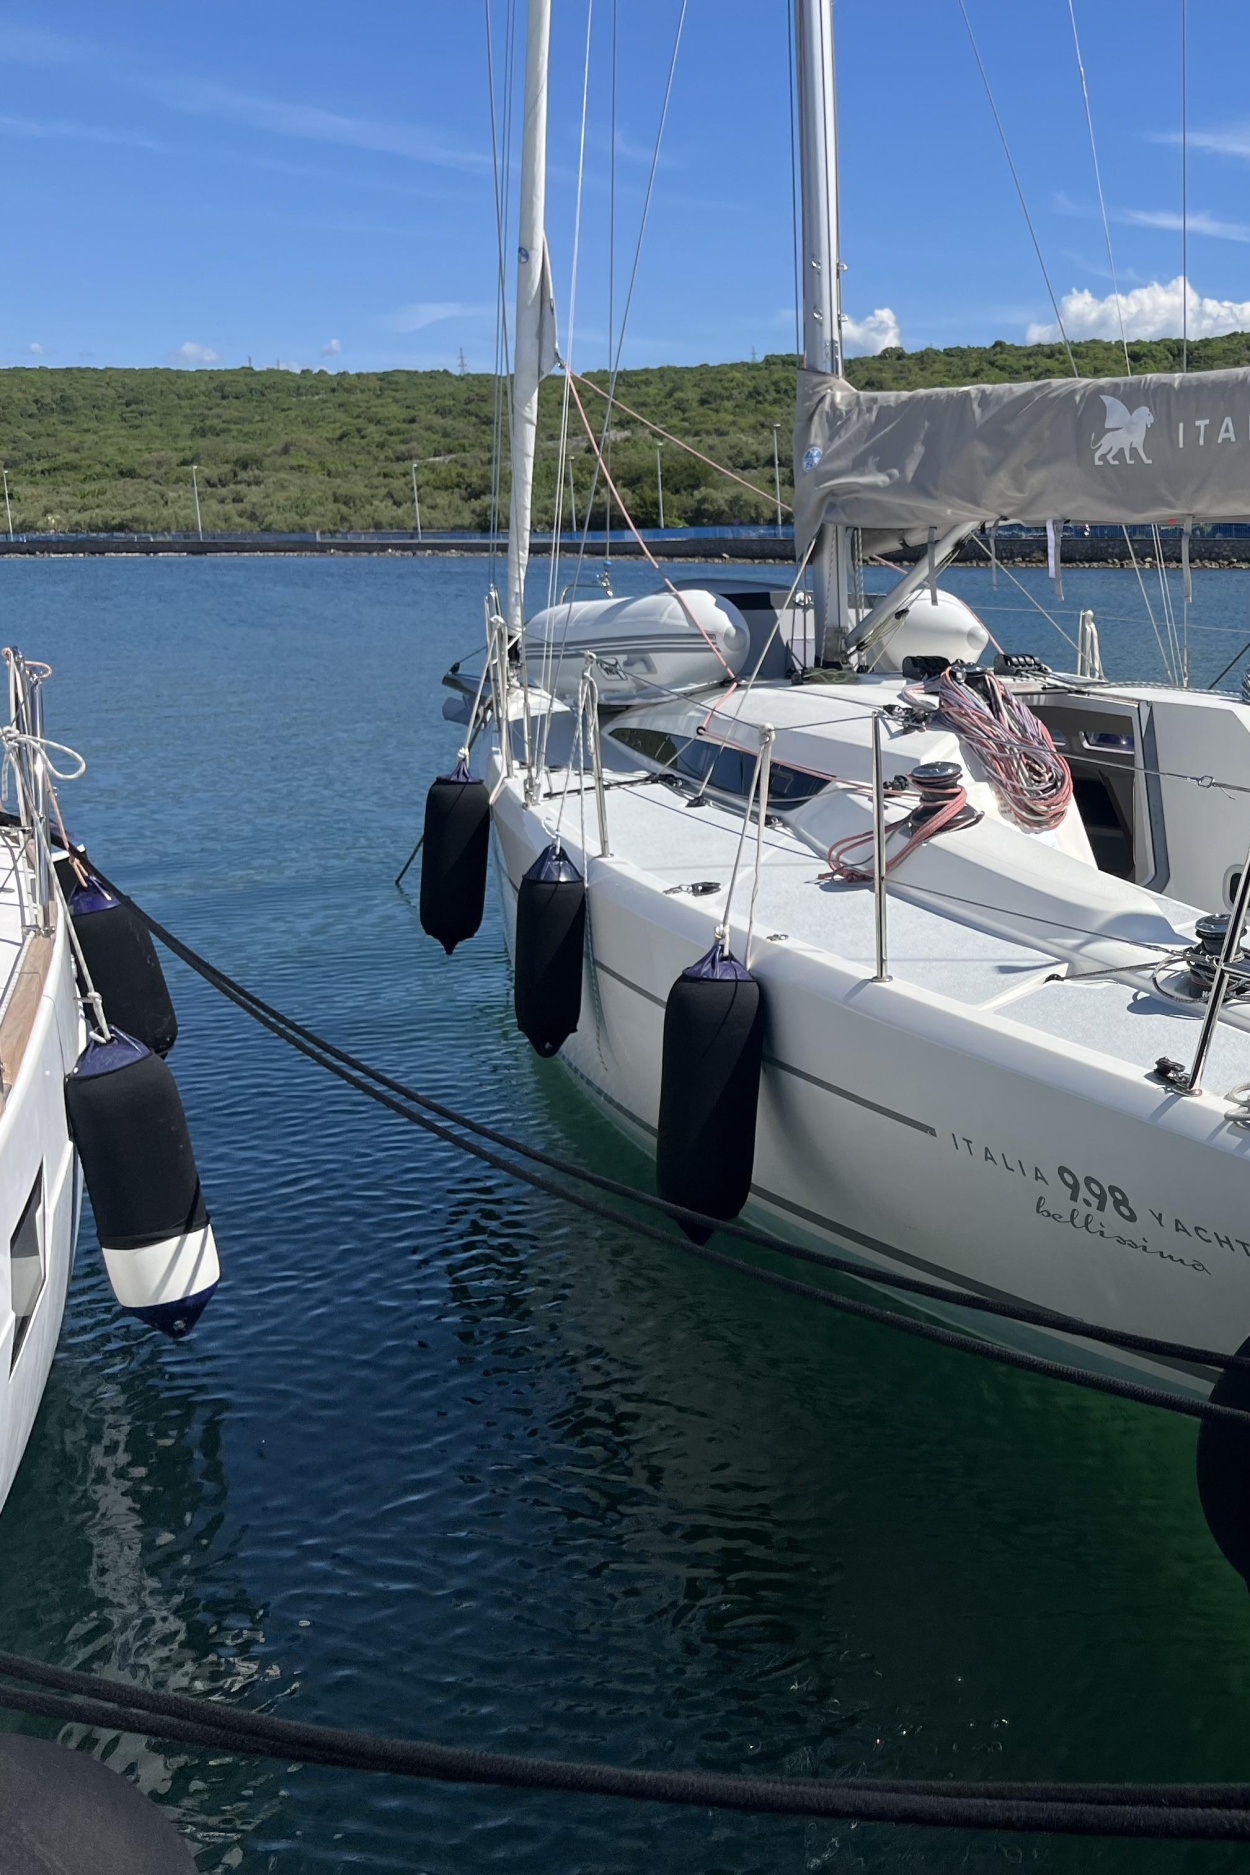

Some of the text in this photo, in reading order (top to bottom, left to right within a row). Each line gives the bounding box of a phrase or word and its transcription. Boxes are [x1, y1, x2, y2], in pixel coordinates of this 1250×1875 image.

[952, 1133, 1049, 1186] ITALIA
[1057, 1165, 1138, 1224] 9.98
[1035, 1196, 1212, 1276] bellissima
